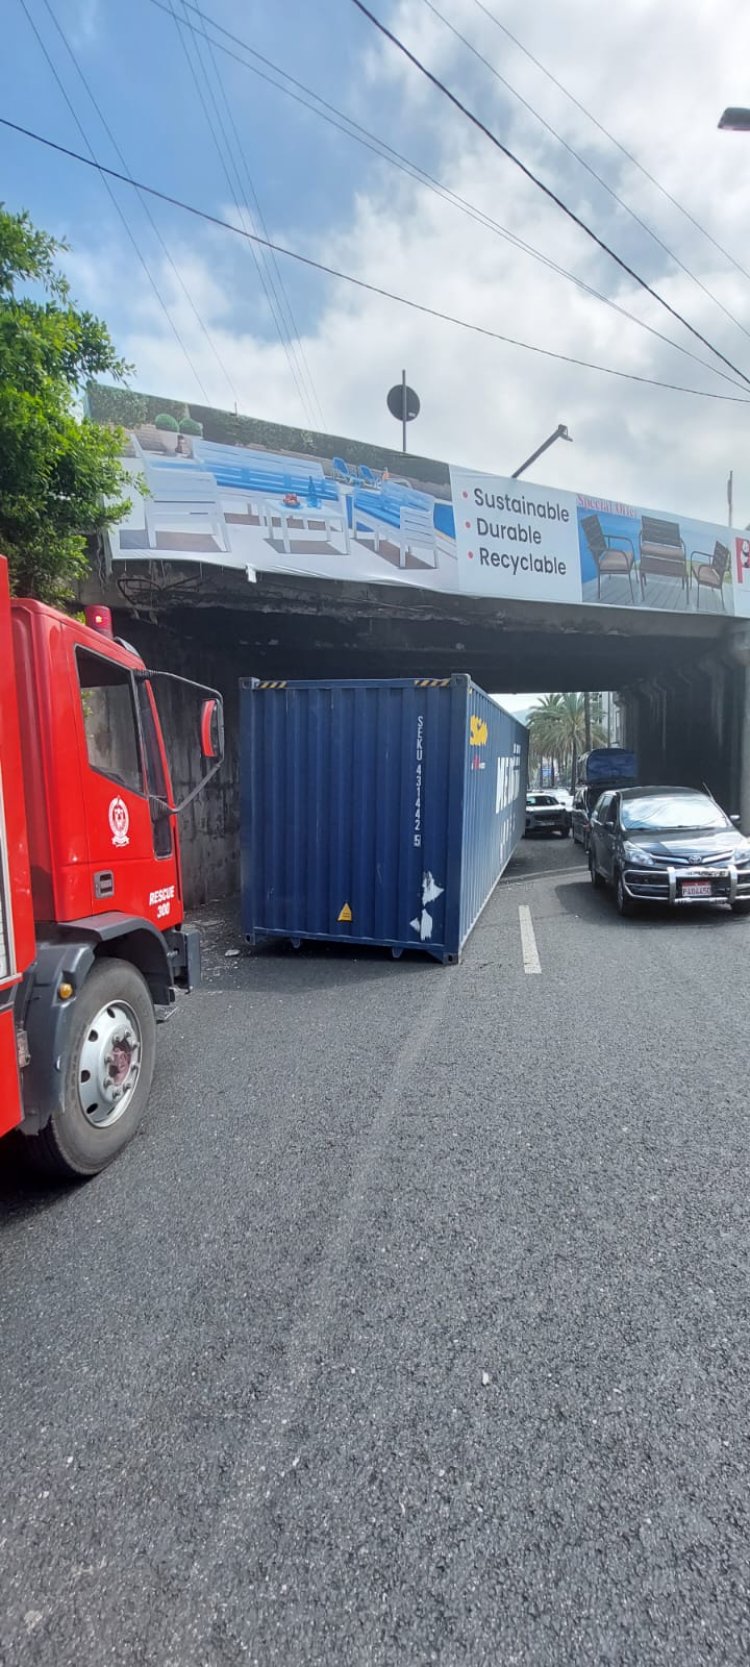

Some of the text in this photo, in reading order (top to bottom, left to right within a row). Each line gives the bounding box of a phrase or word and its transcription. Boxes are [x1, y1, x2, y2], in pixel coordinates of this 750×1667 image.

[474, 488, 570, 522] Sustainable
[477, 518, 542, 545] Durable
[479, 547, 567, 576] Recyclable
[416, 715, 424, 761] SEKU
[149, 885, 175, 906] RESCUE
[157, 901, 170, 918] 300
